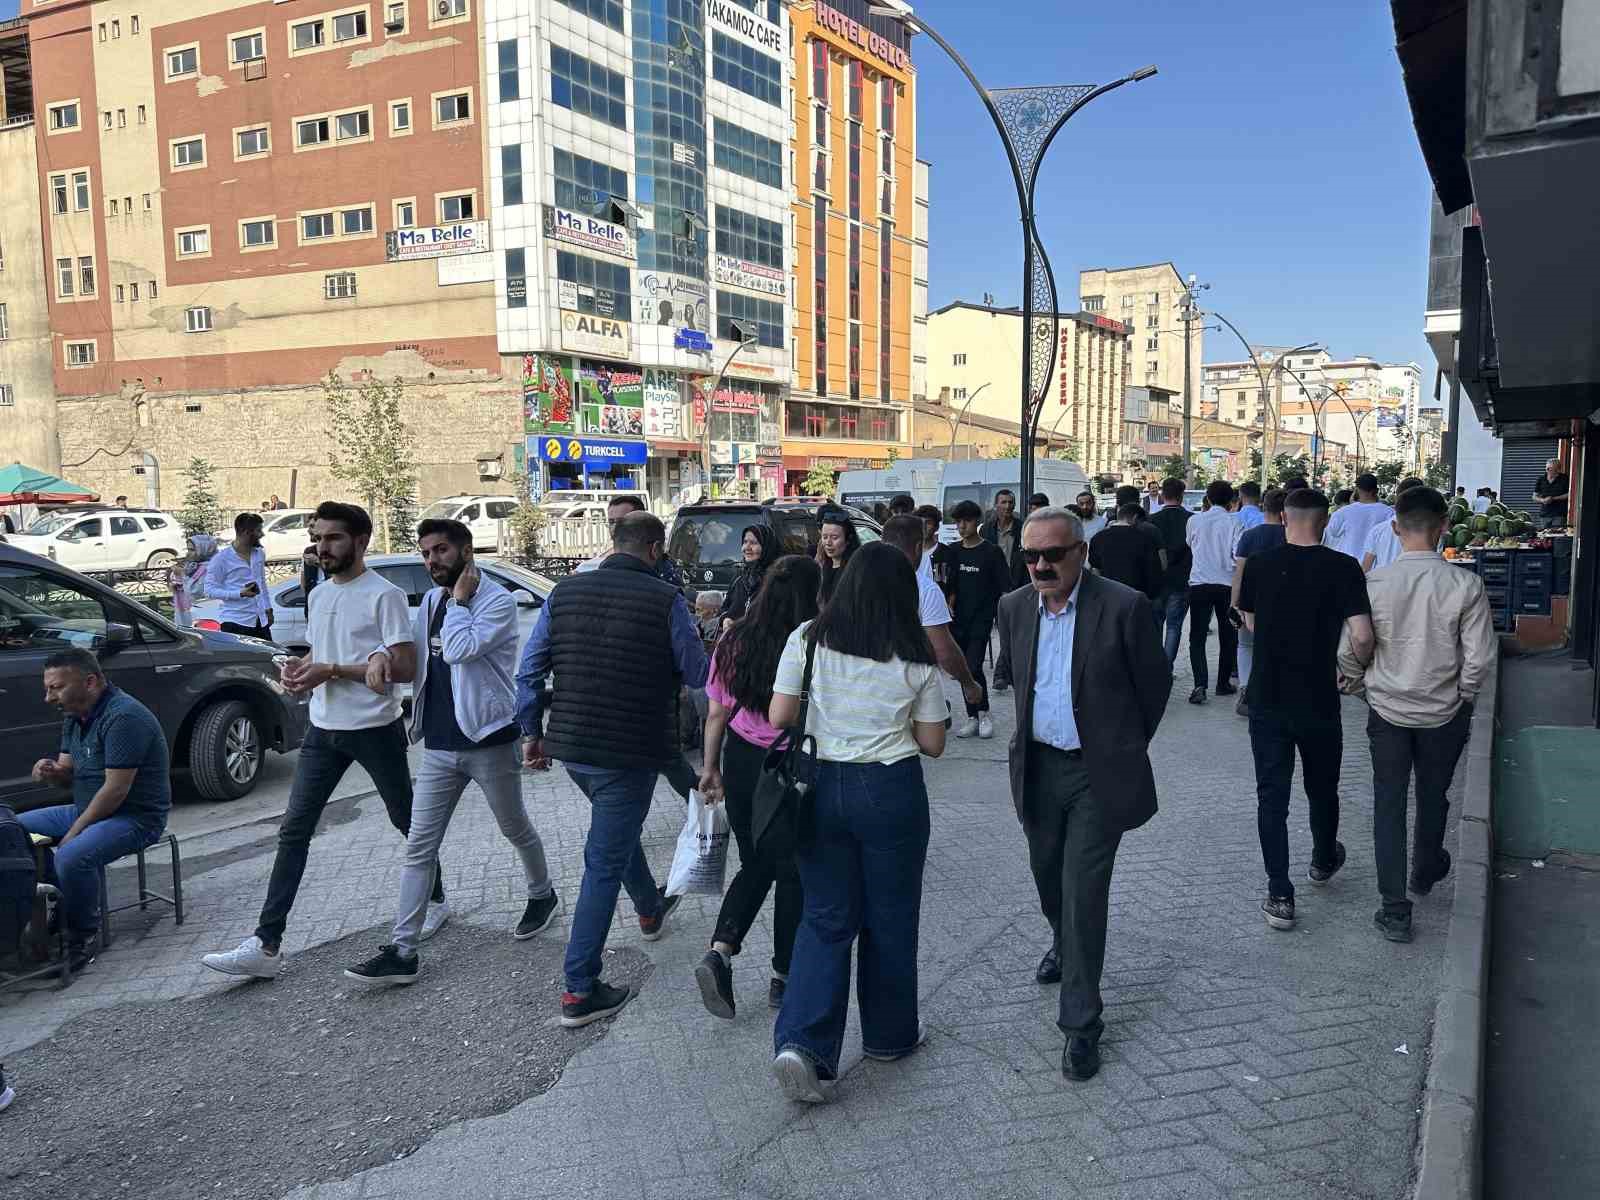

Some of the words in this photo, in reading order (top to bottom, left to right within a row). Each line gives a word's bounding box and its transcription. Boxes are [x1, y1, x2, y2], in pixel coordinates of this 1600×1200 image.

[705, 0, 755, 40] YAKAMOZ
[757, 23, 781, 52] CAFE
[815, 0, 866, 48] HOTEL
[867, 31, 909, 69] OSLO
[400, 231, 425, 246] Ma
[431, 225, 473, 243] Belle
[557, 209, 582, 231] Ma
[587, 218, 624, 241] Belle
[576, 316, 623, 339] ALFA
[1060, 327, 1068, 368] HOTEL
[584, 445, 626, 457] TURKCELL
